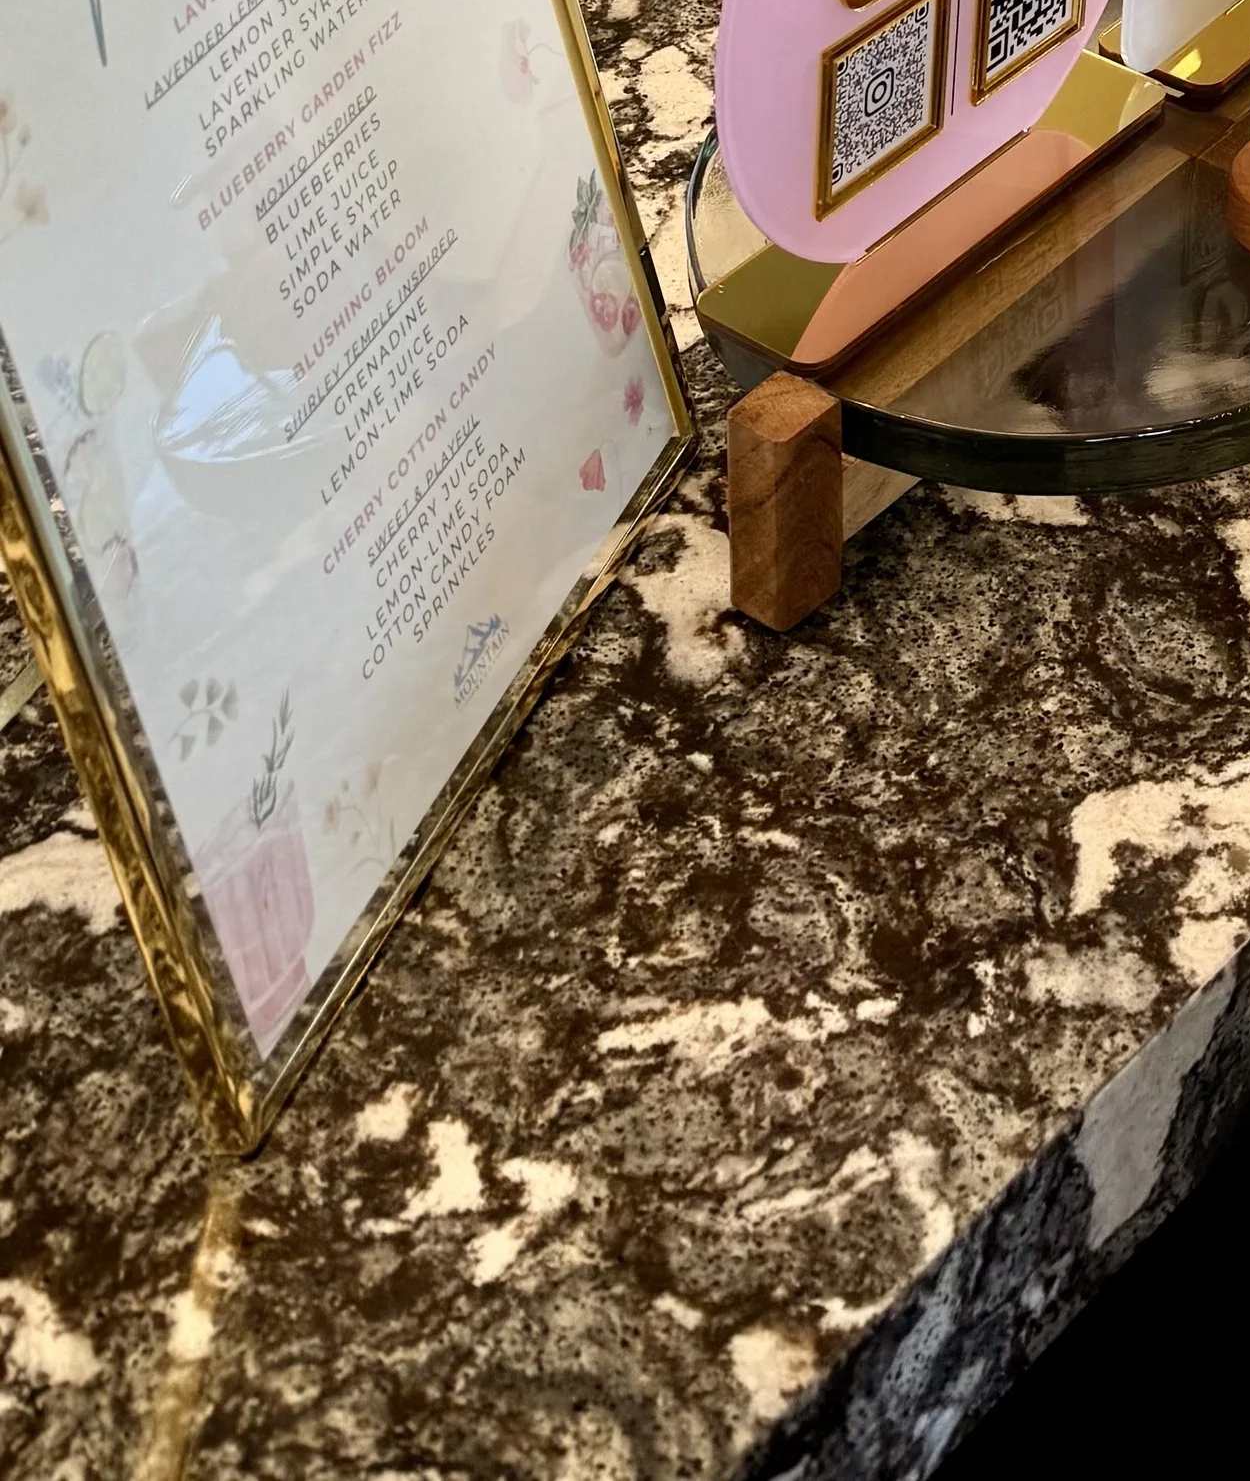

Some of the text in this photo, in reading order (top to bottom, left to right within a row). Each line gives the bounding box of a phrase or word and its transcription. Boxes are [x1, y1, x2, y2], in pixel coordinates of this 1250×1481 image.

[145, 22, 226, 109] LAVENDER
[198, 27, 296, 131] LAVENDER
[204, 49, 305, 158] SPARKLING
[208, 11, 274, 83] LEMON
[197, 10, 404, 232] BLUEBERRY GARDEN FIZZ
[255, 85, 378, 221] MOJITO INSPIRED
[266, 112, 381, 244] BLUEBERRIES
[279, 159, 397, 301] SIMPLE SYRUP
[285, 149, 380, 260] LIME JUICE
[292, 188, 402, 319] SODA WATER
[284, 228, 459, 443] SHIRLEY TEMPLE INSPIRED
[293, 216, 429, 382] BLUSHING BLOOM
[333, 295, 428, 416] GRENADINE
[320, 314, 469, 506] LEMON-LIME SODA
[344, 323, 434, 442] LIME JUICE
[322, 341, 497, 575] CHERRY COTTON CANDY
[367, 414, 481, 567] SWEET & PLAYFUL
[376, 435, 486, 588] CHERRY JUICE
[362, 447, 526, 681] COTTON CANDY FOAM
[366, 442, 510, 642] LEMON-LIME SODA
[413, 521, 496, 644] SPRINKLES
[454, 620, 512, 704] MOUNTAIN
